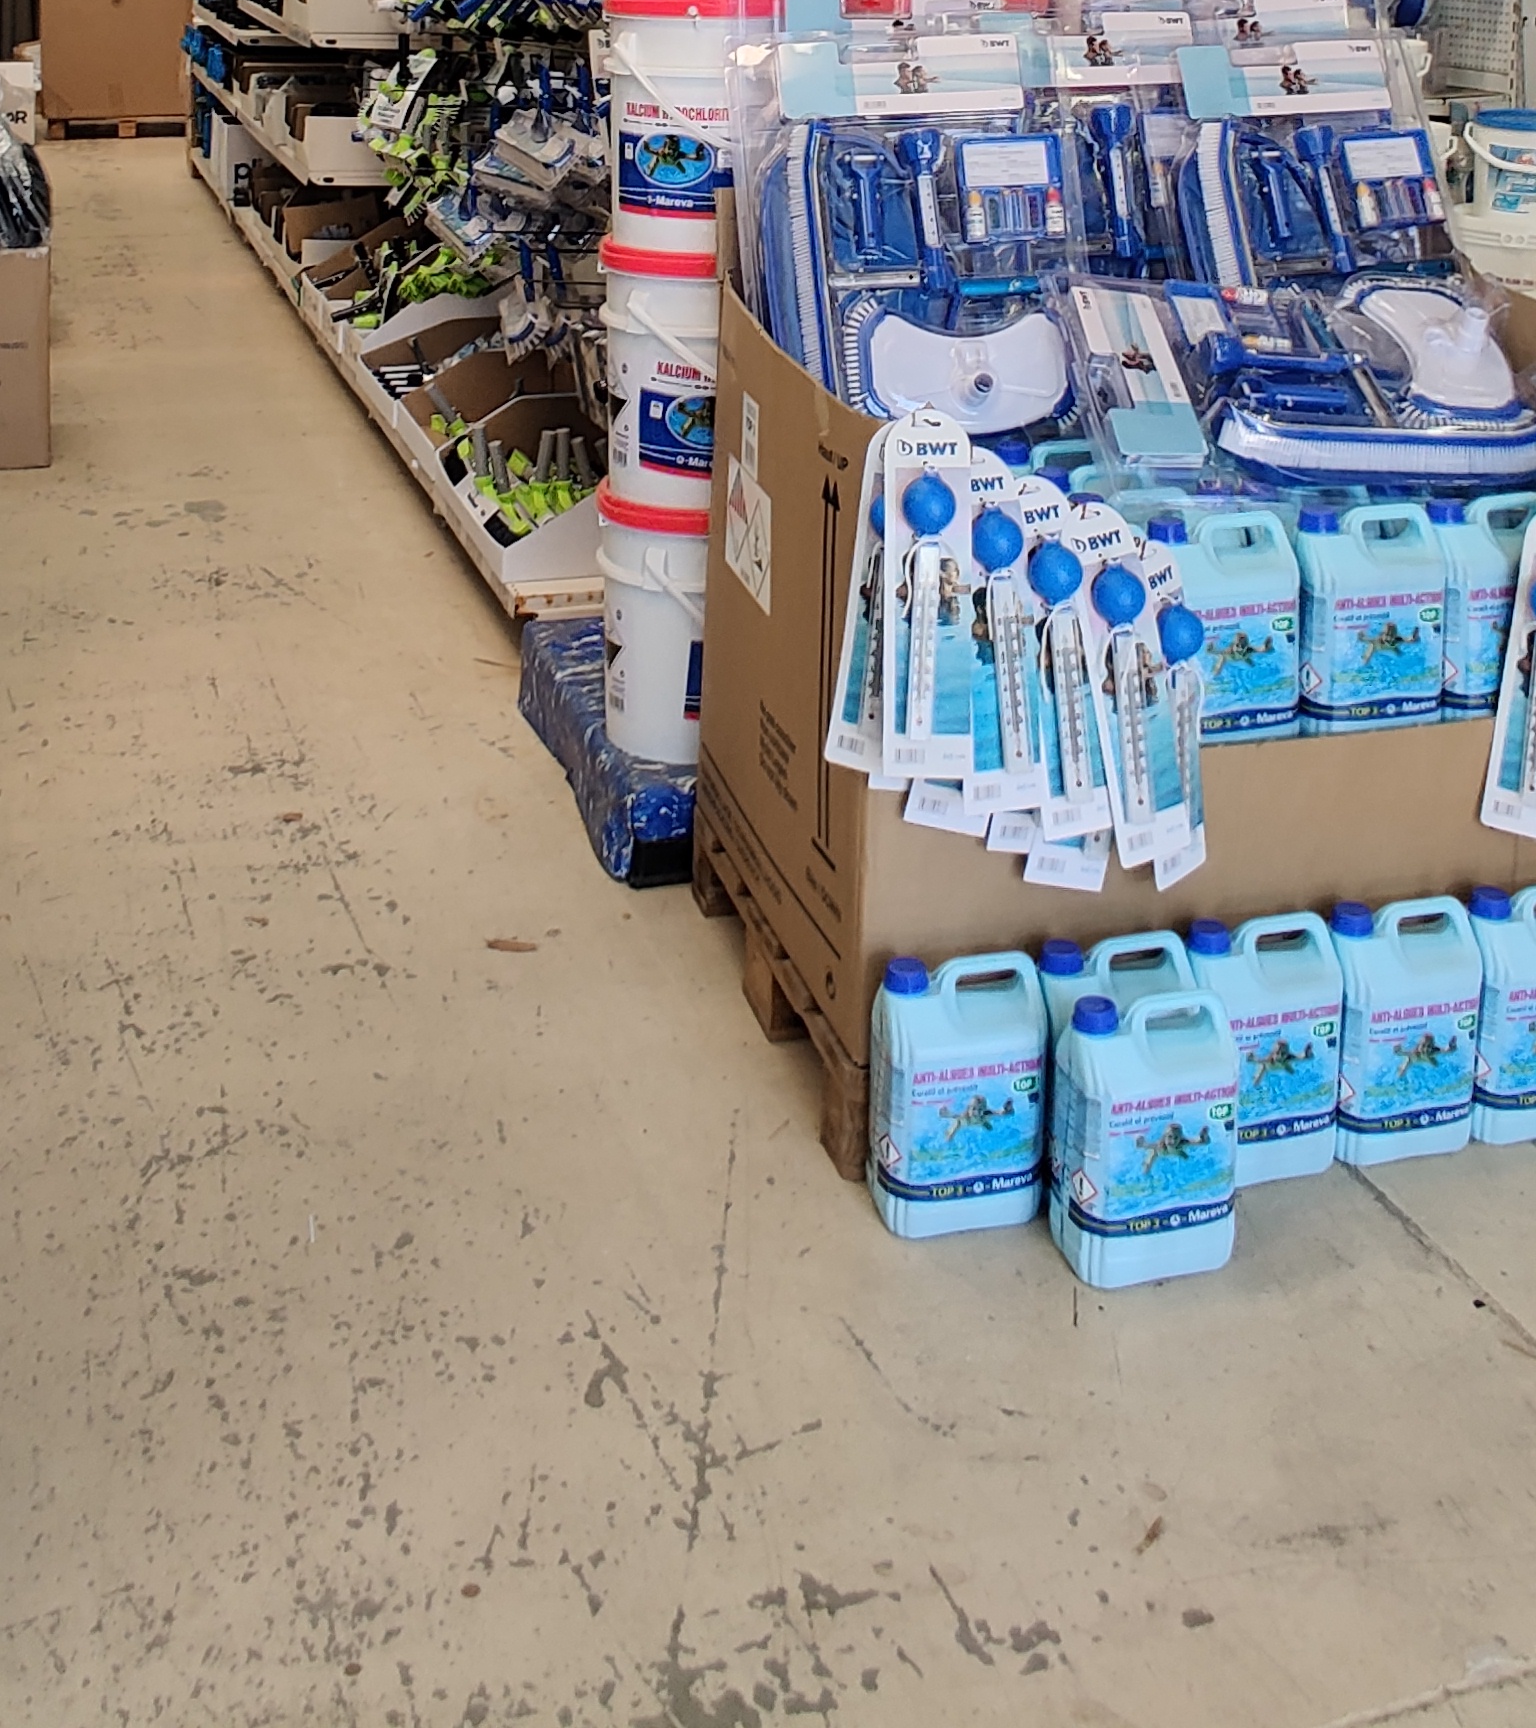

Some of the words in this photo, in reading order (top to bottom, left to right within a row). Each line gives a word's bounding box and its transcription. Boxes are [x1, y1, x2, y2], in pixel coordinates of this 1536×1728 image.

[626, 101, 660, 119] KALCIUM
[654, 195, 694, 208] Mareva
[657, 360, 702, 382] KALCIUM
[916, 442, 958, 456] BWT
[970, 476, 1004, 493] BWT
[1024, 504, 1060, 525] BWT
[1088, 529, 1121, 551] BWT
[1148, 566, 1174, 592] BWT
[1349, 705, 1370, 718] TOP
[1401, 700, 1437, 714] Mareva
[1203, 718, 1224, 730] TOP
[1256, 709, 1295, 723] Mareva
[1314, 1023, 1334, 1035] TOP
[1435, 1105, 1470, 1122] Mareva
[1238, 1127, 1260, 1141] TOP
[1293, 1116, 1330, 1133] Mareva
[992, 1171, 1033, 1190] Mareva
[1188, 1203, 1229, 1222] Mareva
